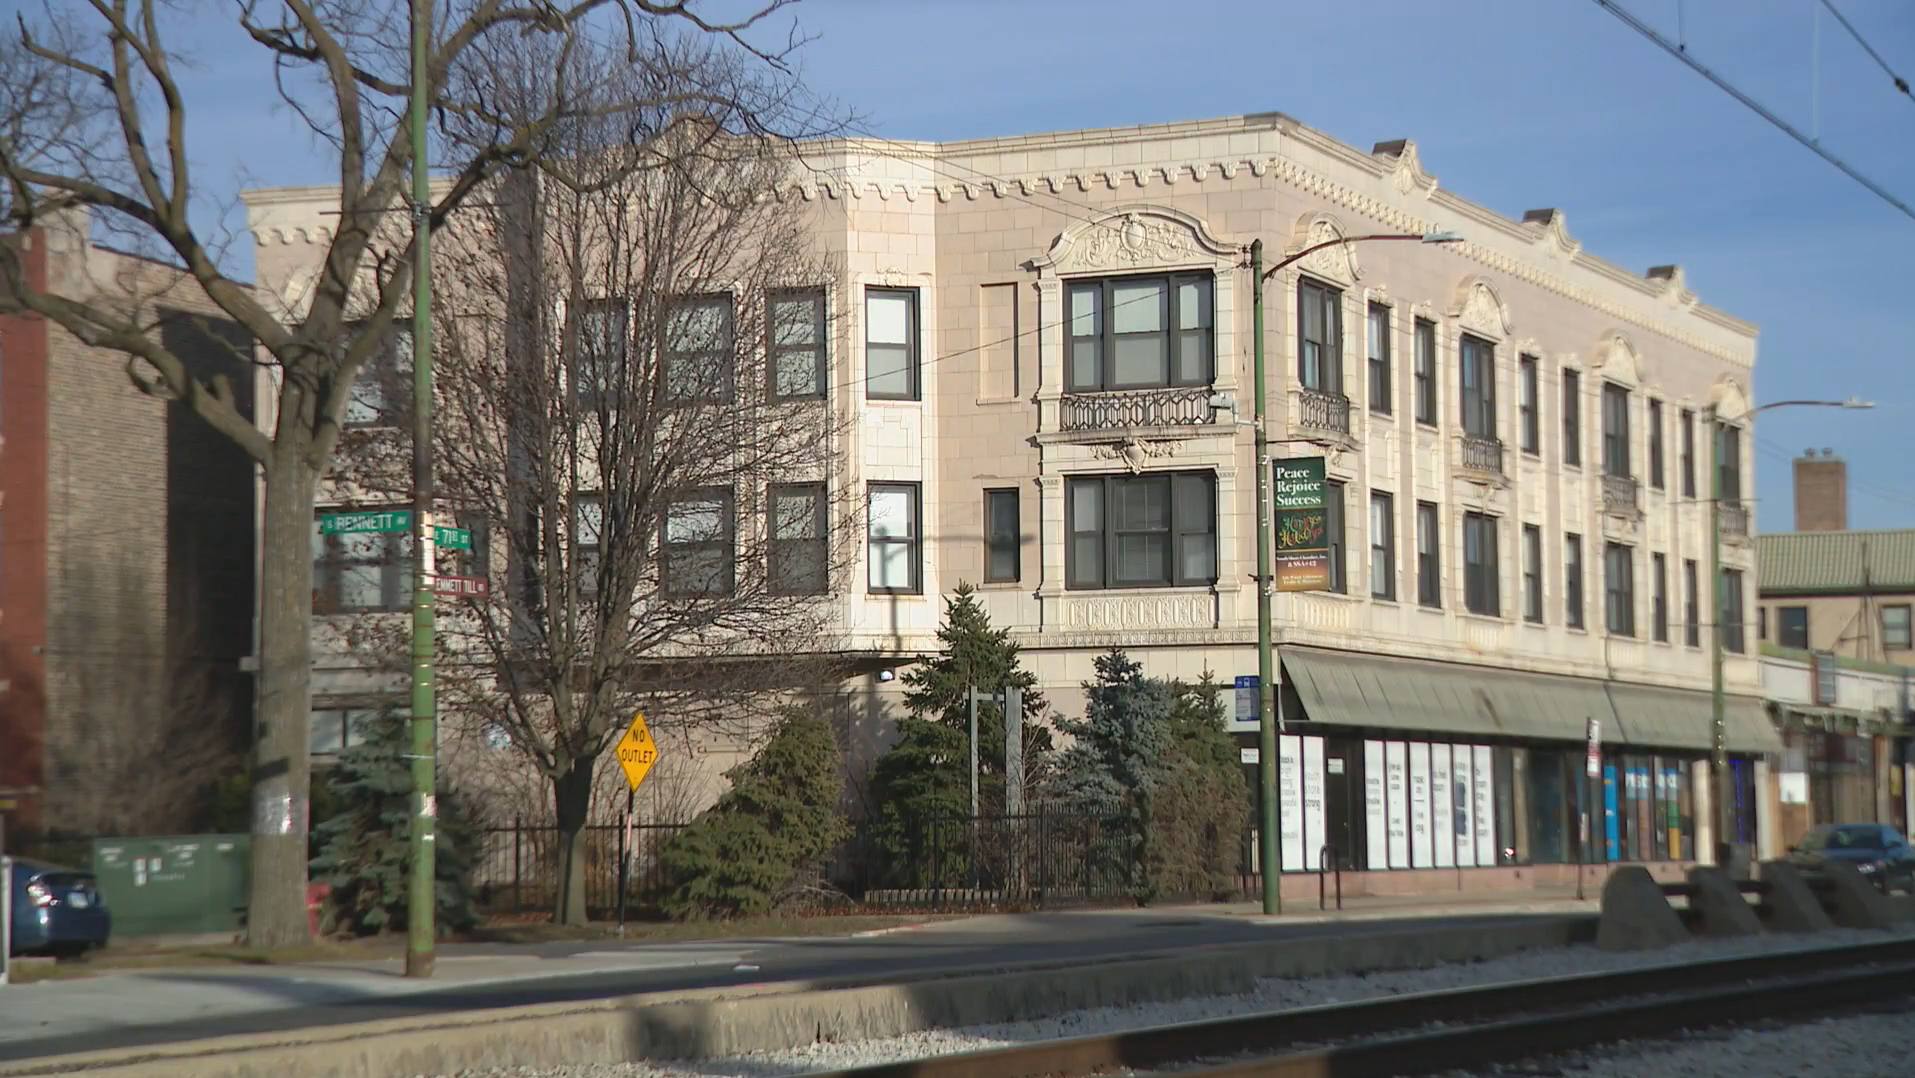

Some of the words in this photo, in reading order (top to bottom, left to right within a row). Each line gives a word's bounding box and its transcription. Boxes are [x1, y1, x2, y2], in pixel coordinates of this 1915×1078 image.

[1276, 467, 1310, 479] Peace
[1277, 479, 1321, 496] Rejoice
[1276, 494, 1321, 506] Success
[336, 514, 392, 530] BENNETT
[436, 578, 462, 593] EMMETT
[463, 580, 477, 594] TILL
[633, 729, 645, 743] NO
[621, 748, 653, 763] OUTLET
